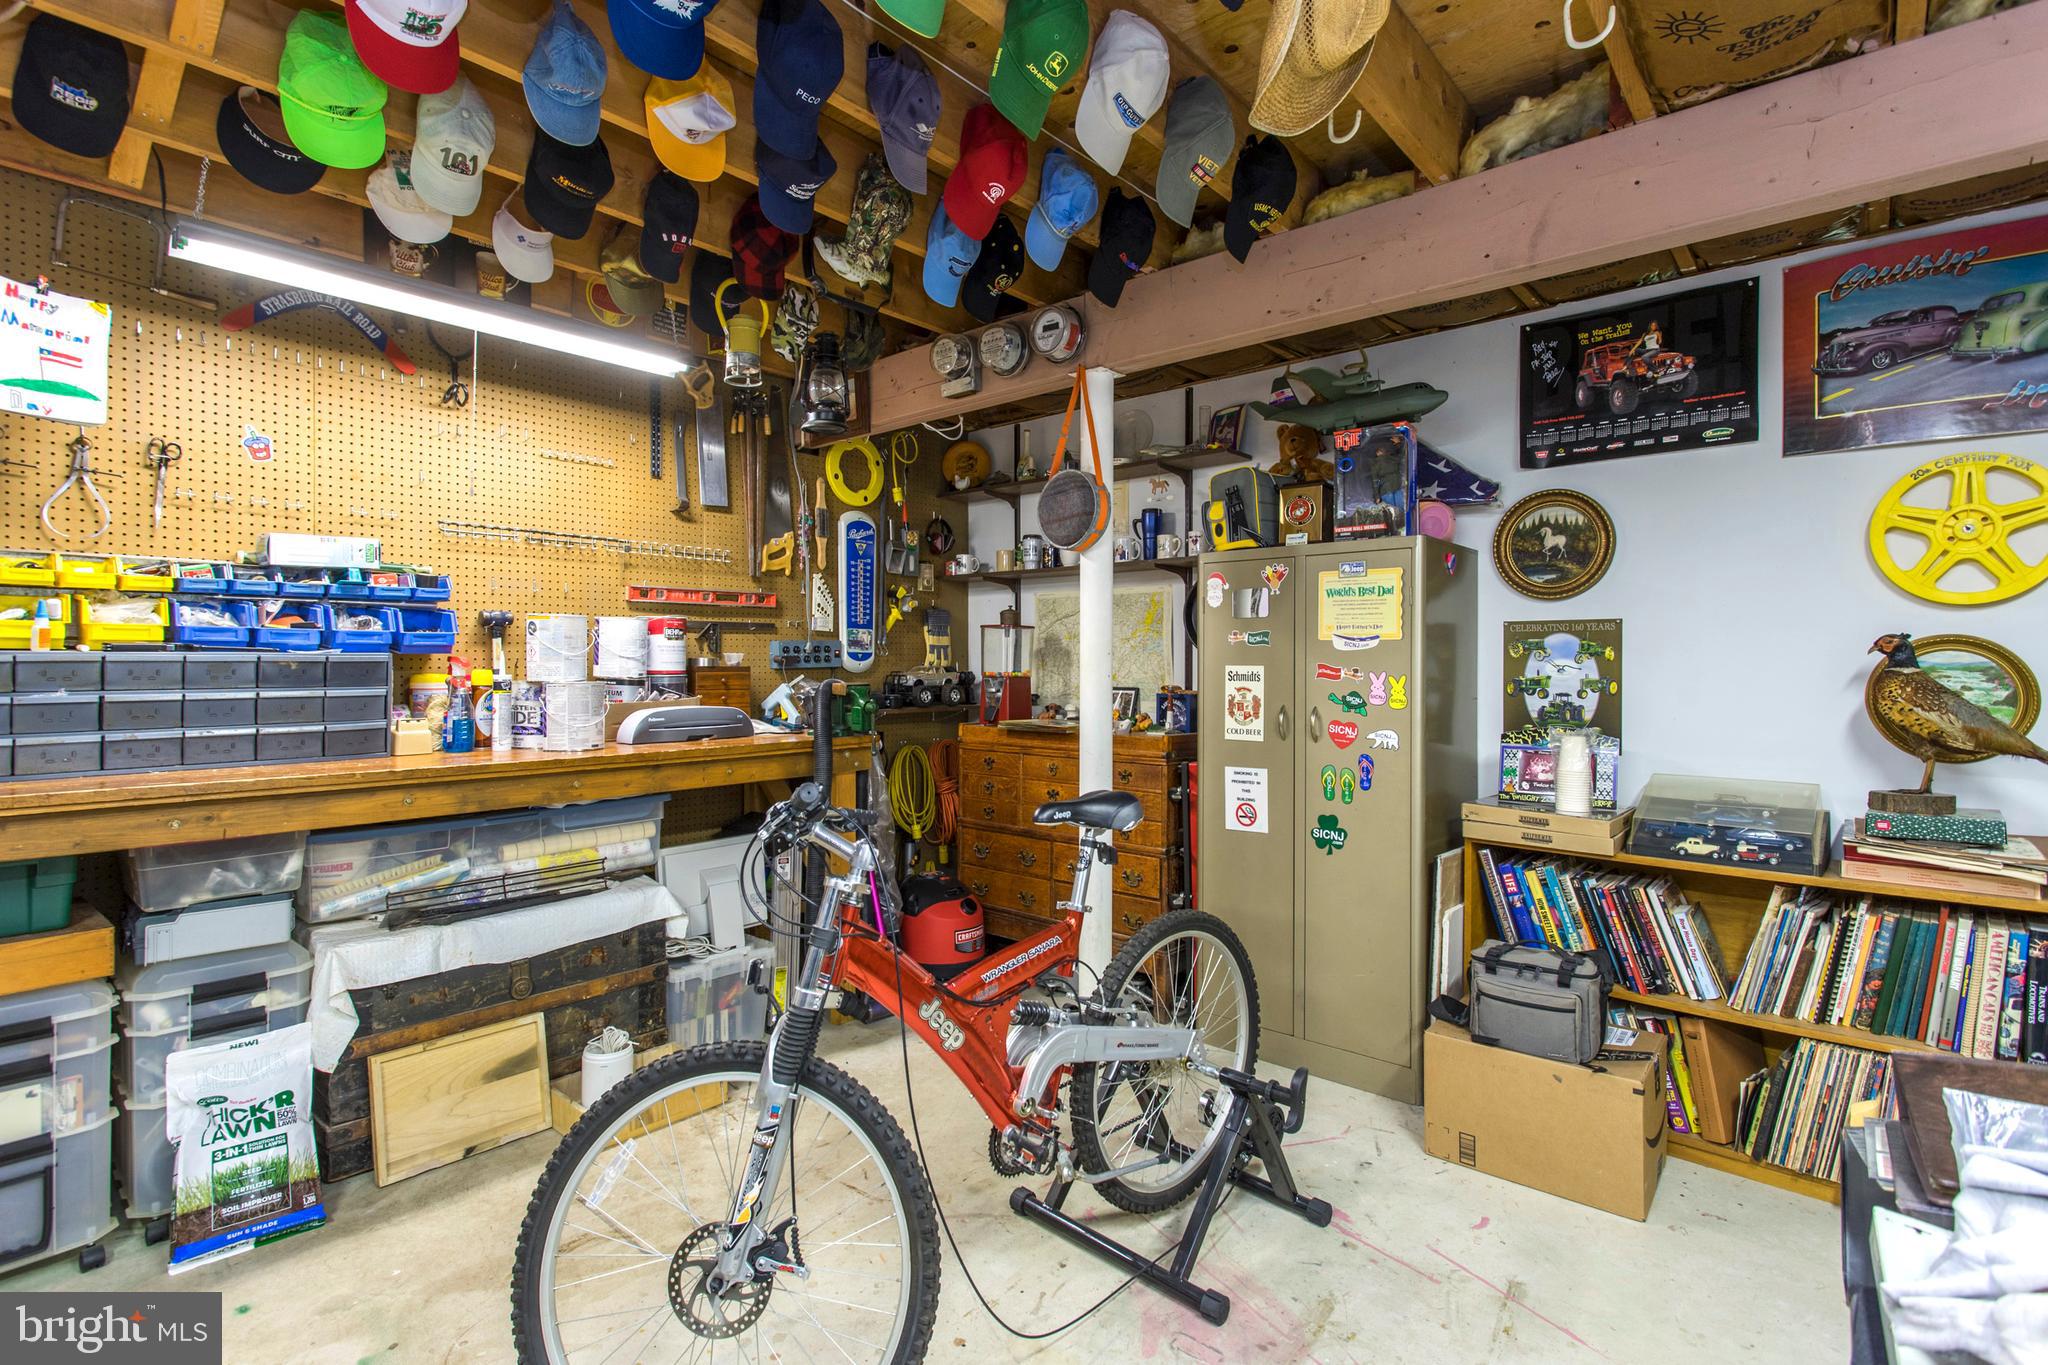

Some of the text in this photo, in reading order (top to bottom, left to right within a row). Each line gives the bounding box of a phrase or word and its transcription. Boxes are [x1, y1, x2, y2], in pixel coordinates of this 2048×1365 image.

[1026, 63, 1045, 86] JOHN
[796, 88, 821, 105] PECO
[243, 122, 302, 162] SURF CITY
[395, 259, 417, 272] Club
[259, 287, 383, 340] STRASBURG RAIL ROAD
[1592, 326, 1613, 336] Want
[1616, 322, 1633, 332] You
[1934, 453, 2000, 469] CENTURY
[2005, 456, 2034, 472] FOX
[1325, 585, 1395, 598] World's Best Dad
[1509, 624, 1570, 633] CELEBRATING
[1586, 621, 1616, 631] YEARS
[1227, 670, 1261, 682] Schmidt's
[1226, 727, 1262, 737] COLD BEER
[1328, 724, 1358, 736] SICNJ
[1053, 809, 1072, 820] Jeep
[1312, 828, 1345, 841] SICNJ
[311, 862, 354, 875] PRIMER
[1502, 873, 1518, 894] LIFE
[981, 935, 1063, 983] WRANGLER SAHARA
[1986, 932, 2005, 993] AMERICAN
[2027, 979, 2039, 1025] LOCOMOTIVES
[917, 996, 967, 1053] Jeep
[229, 1038, 260, 1050] NEW!
[201, 1110, 277, 1147] LAWN
[214, 1146, 248, 1161] 3-IN-1
[242, 1166, 262, 1176] SEED
[231, 1179, 273, 1195] FERTILIZER
[221, 1192, 283, 1214] SOIL IMPROVER
[226, 1230, 243, 1240] SUN
[251, 1220, 279, 1232] SHADE
